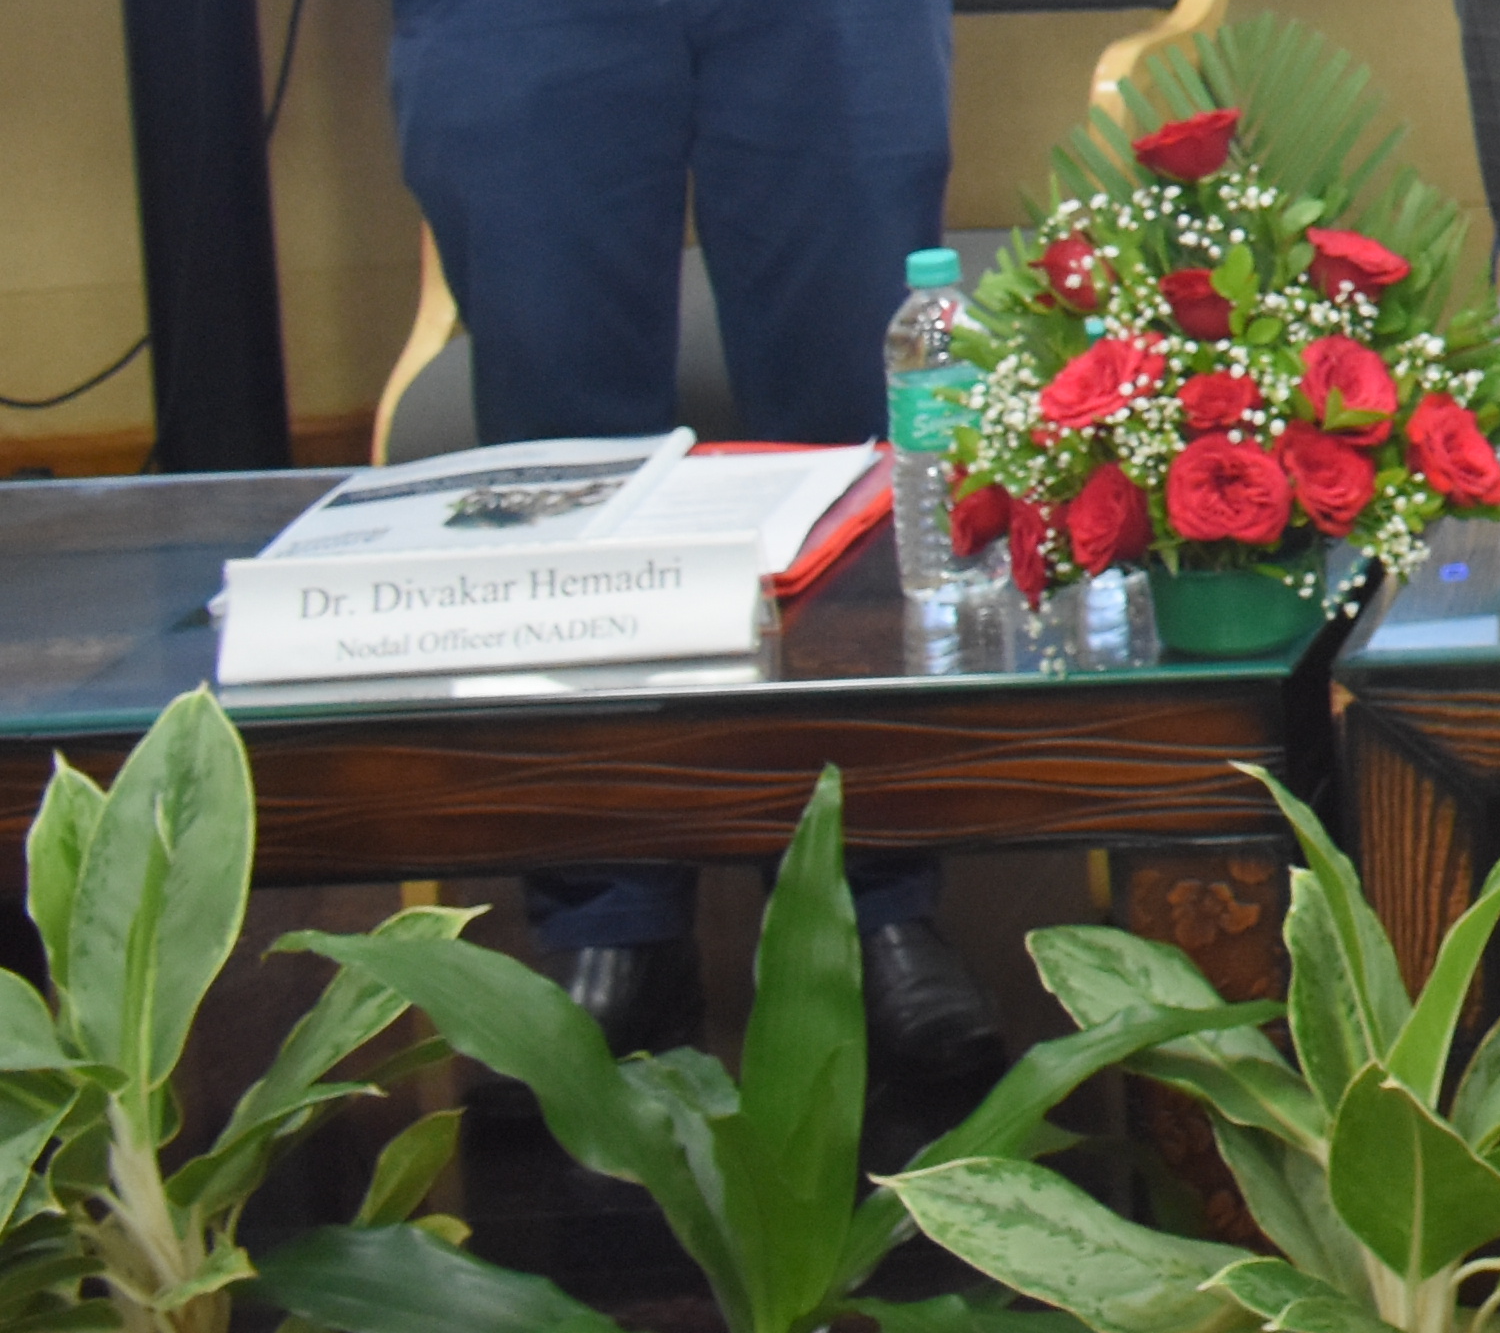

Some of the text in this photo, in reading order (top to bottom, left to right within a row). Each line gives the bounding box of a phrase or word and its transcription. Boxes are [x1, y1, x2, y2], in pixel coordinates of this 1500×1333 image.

[299, 557, 683, 621] Dr. Divakar Hemadri
[335, 613, 640, 661] Nodal Officer (NADEN)
